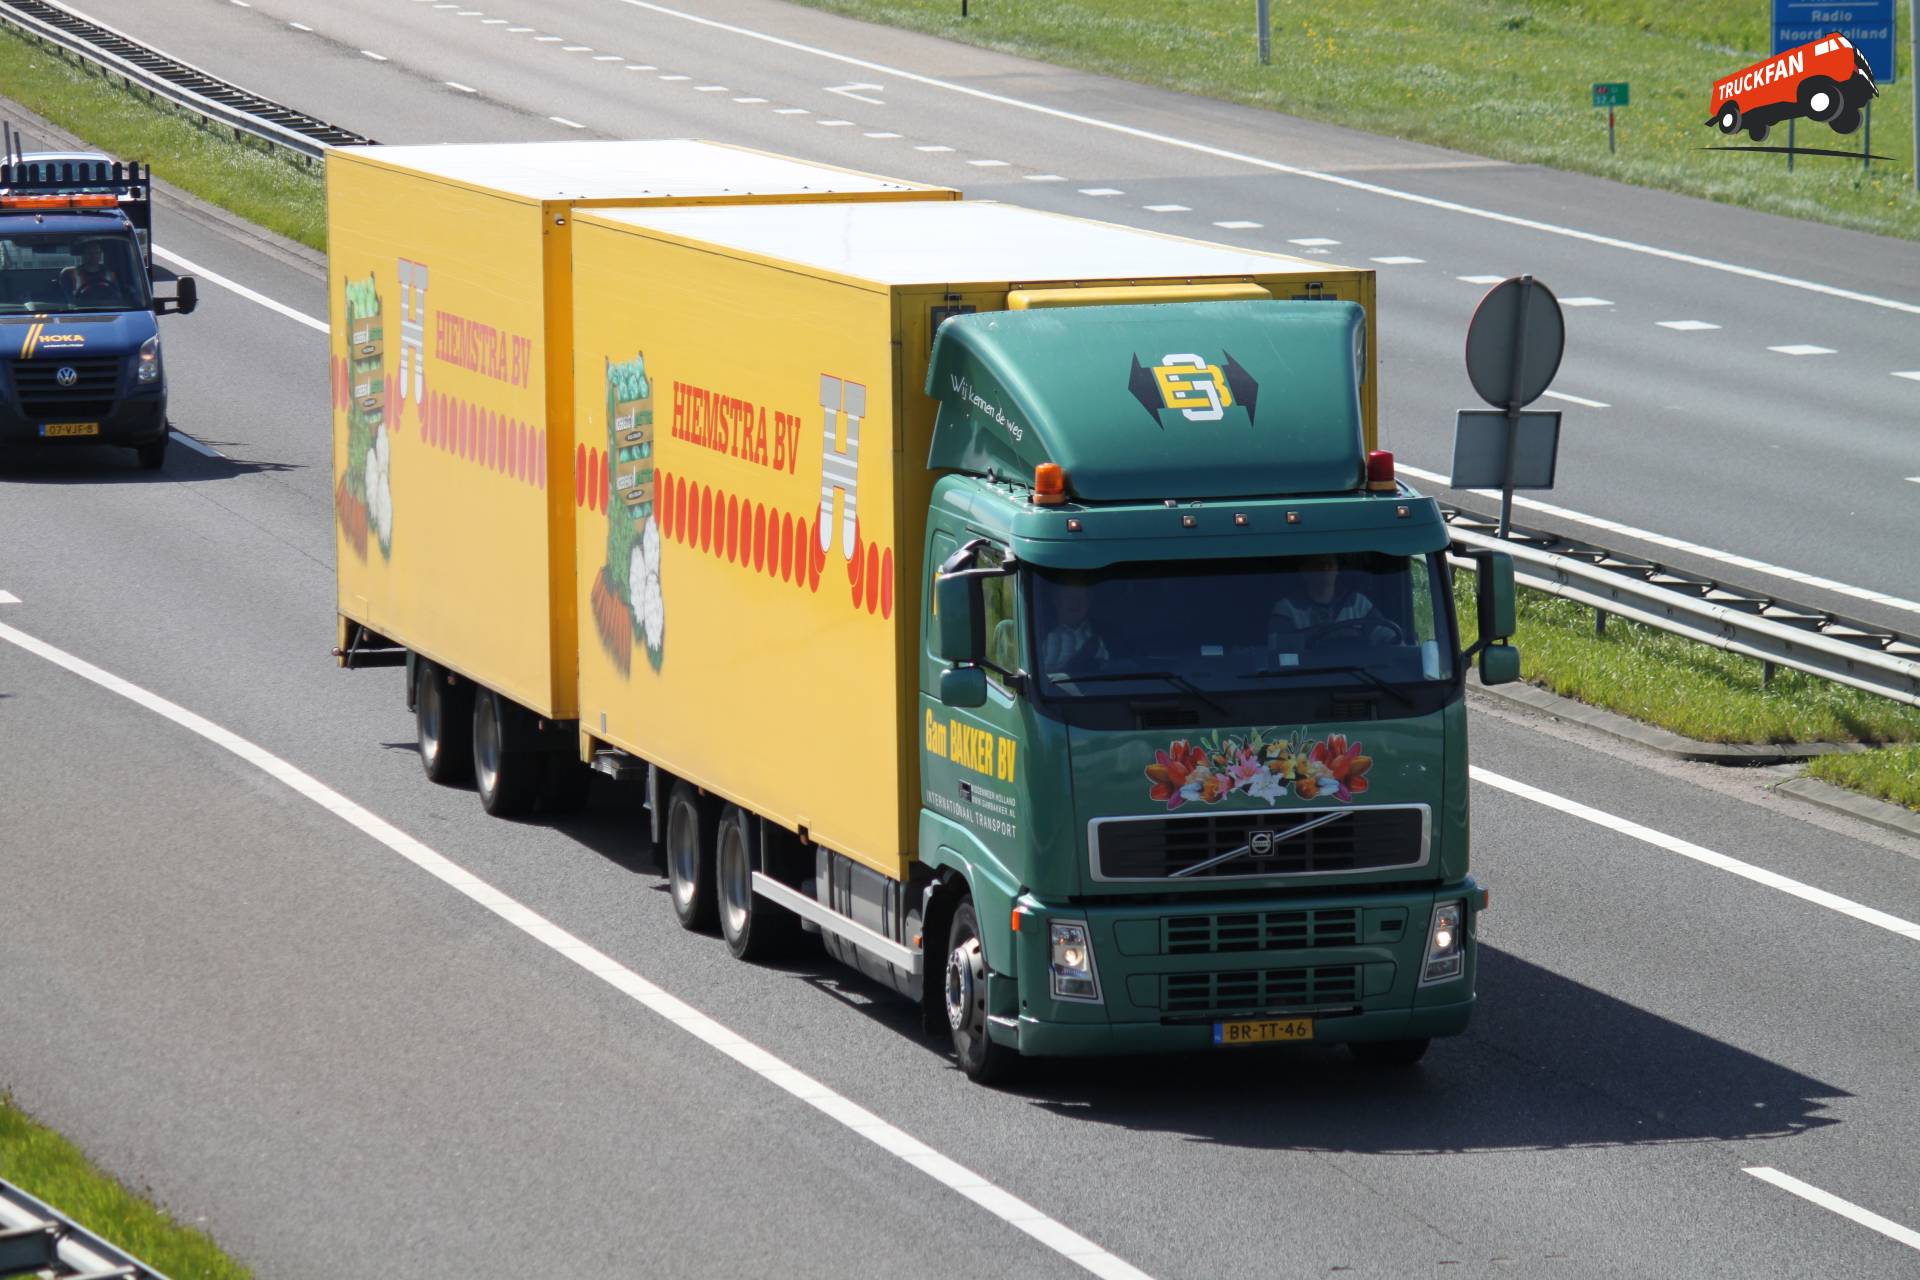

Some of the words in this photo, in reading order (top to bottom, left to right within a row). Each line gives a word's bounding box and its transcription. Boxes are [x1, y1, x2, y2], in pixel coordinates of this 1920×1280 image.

[1811, 10, 1853, 22] Radio
[39, 335, 85, 343] HOKA
[436, 310, 508, 383] HIEMSTRA
[511, 334, 532, 390] BV
[672, 380, 769, 467] HIEMSTRA
[773, 410, 801, 476] BV
[950, 373, 968, 400] Wij
[968, 385, 995, 418] kennen
[995, 407, 1006, 425] de
[1006, 419, 1023, 441] weg
[925, 707, 947, 758] Gam
[950, 719, 994, 777] BAKKER
[997, 736, 1017, 784] BV
[926, 790, 974, 823] INTERNATIONAAL
[975, 811, 1017, 838] TRANSPORT
[1229, 1022, 1307, 1040] BR-TT-46
